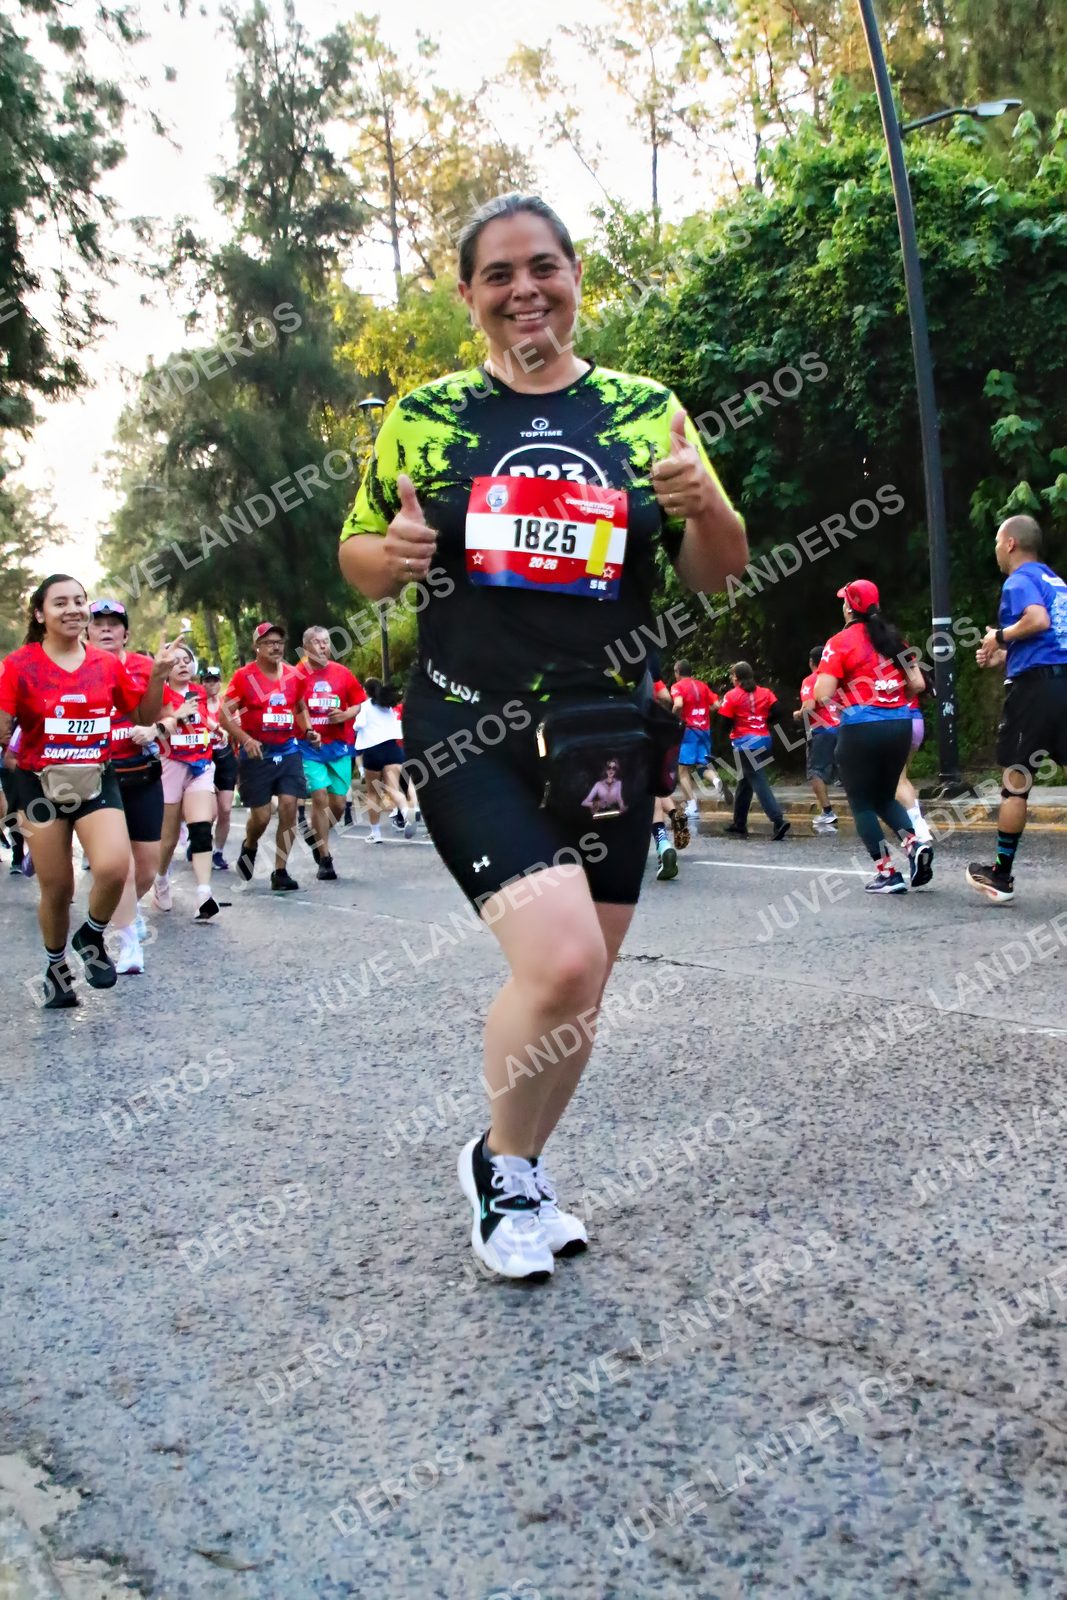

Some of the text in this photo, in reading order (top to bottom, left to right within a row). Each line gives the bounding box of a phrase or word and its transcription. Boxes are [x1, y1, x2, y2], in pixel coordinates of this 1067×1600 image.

[520, 430, 563, 438] TOPTIME
[513, 517, 578, 555] 1825
[590, 579, 607, 590] 5K
[68, 720, 95, 733] 2727
[41, 746, 102, 760] SANTIAGO
